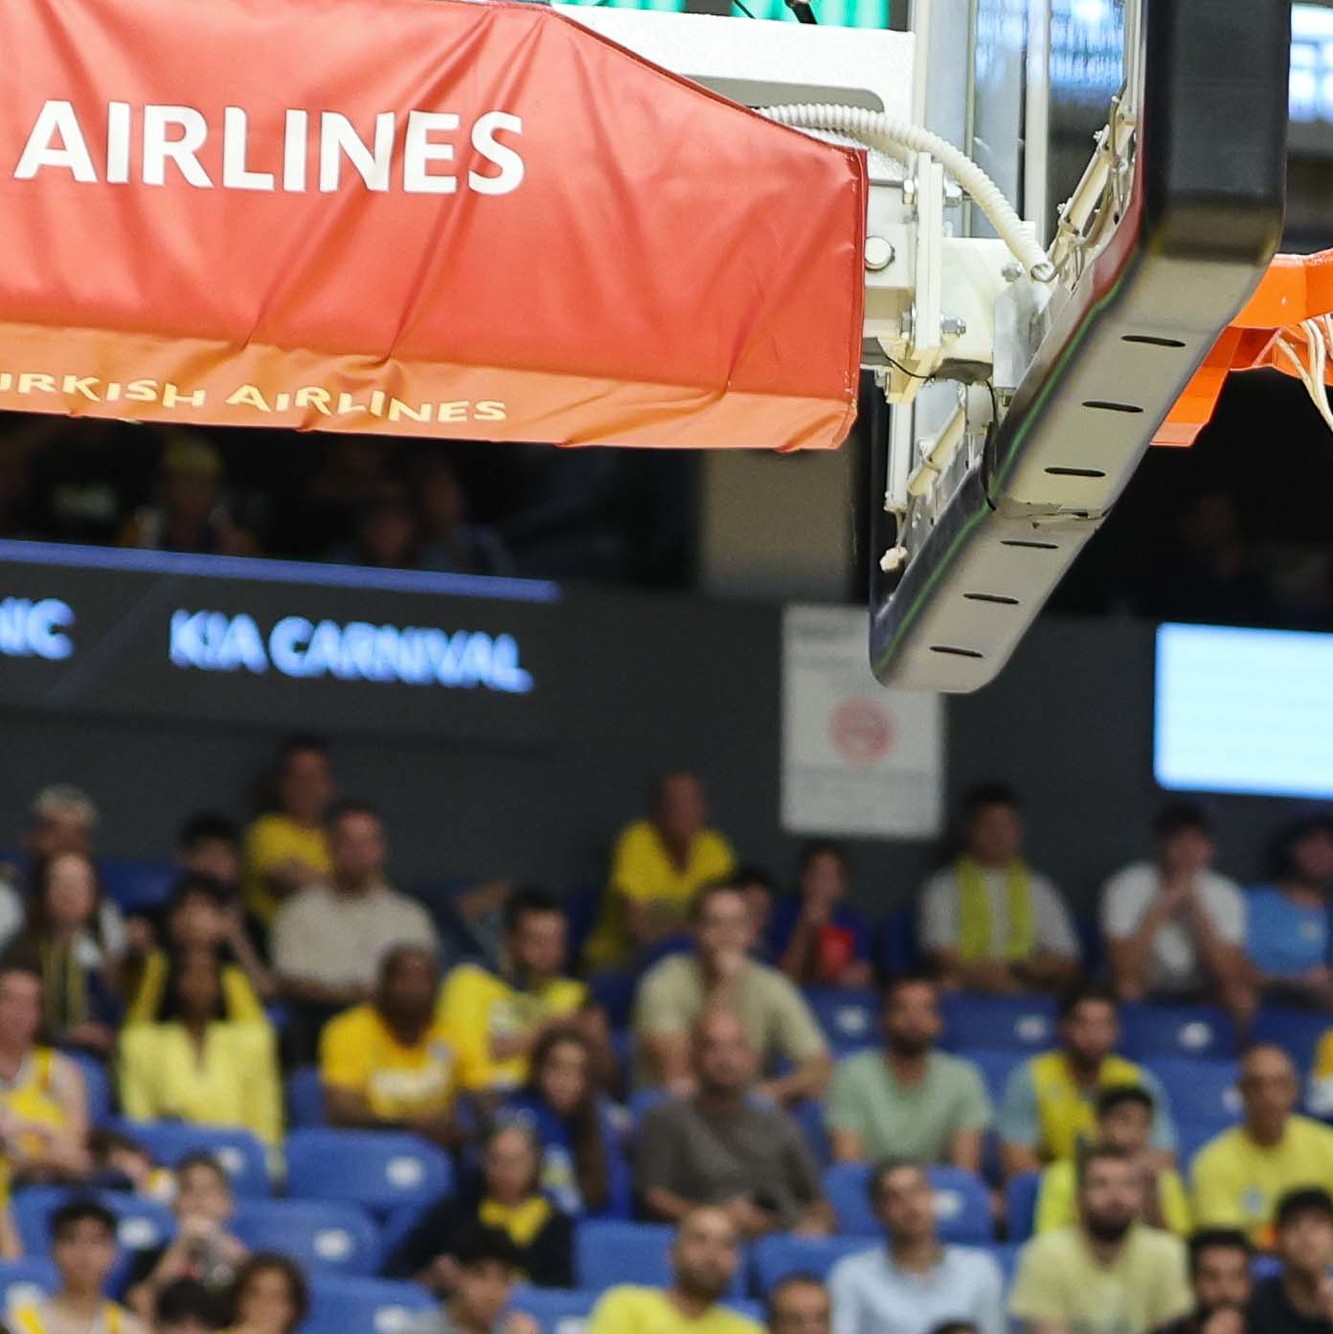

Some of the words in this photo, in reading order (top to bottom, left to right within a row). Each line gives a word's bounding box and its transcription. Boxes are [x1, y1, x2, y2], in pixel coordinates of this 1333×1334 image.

[13, 100, 525, 195] AIRLINES
[225, 383, 507, 422] AIRLINES
[169, 608, 268, 675] KIA
[268, 615, 534, 694] CARNIVAL
